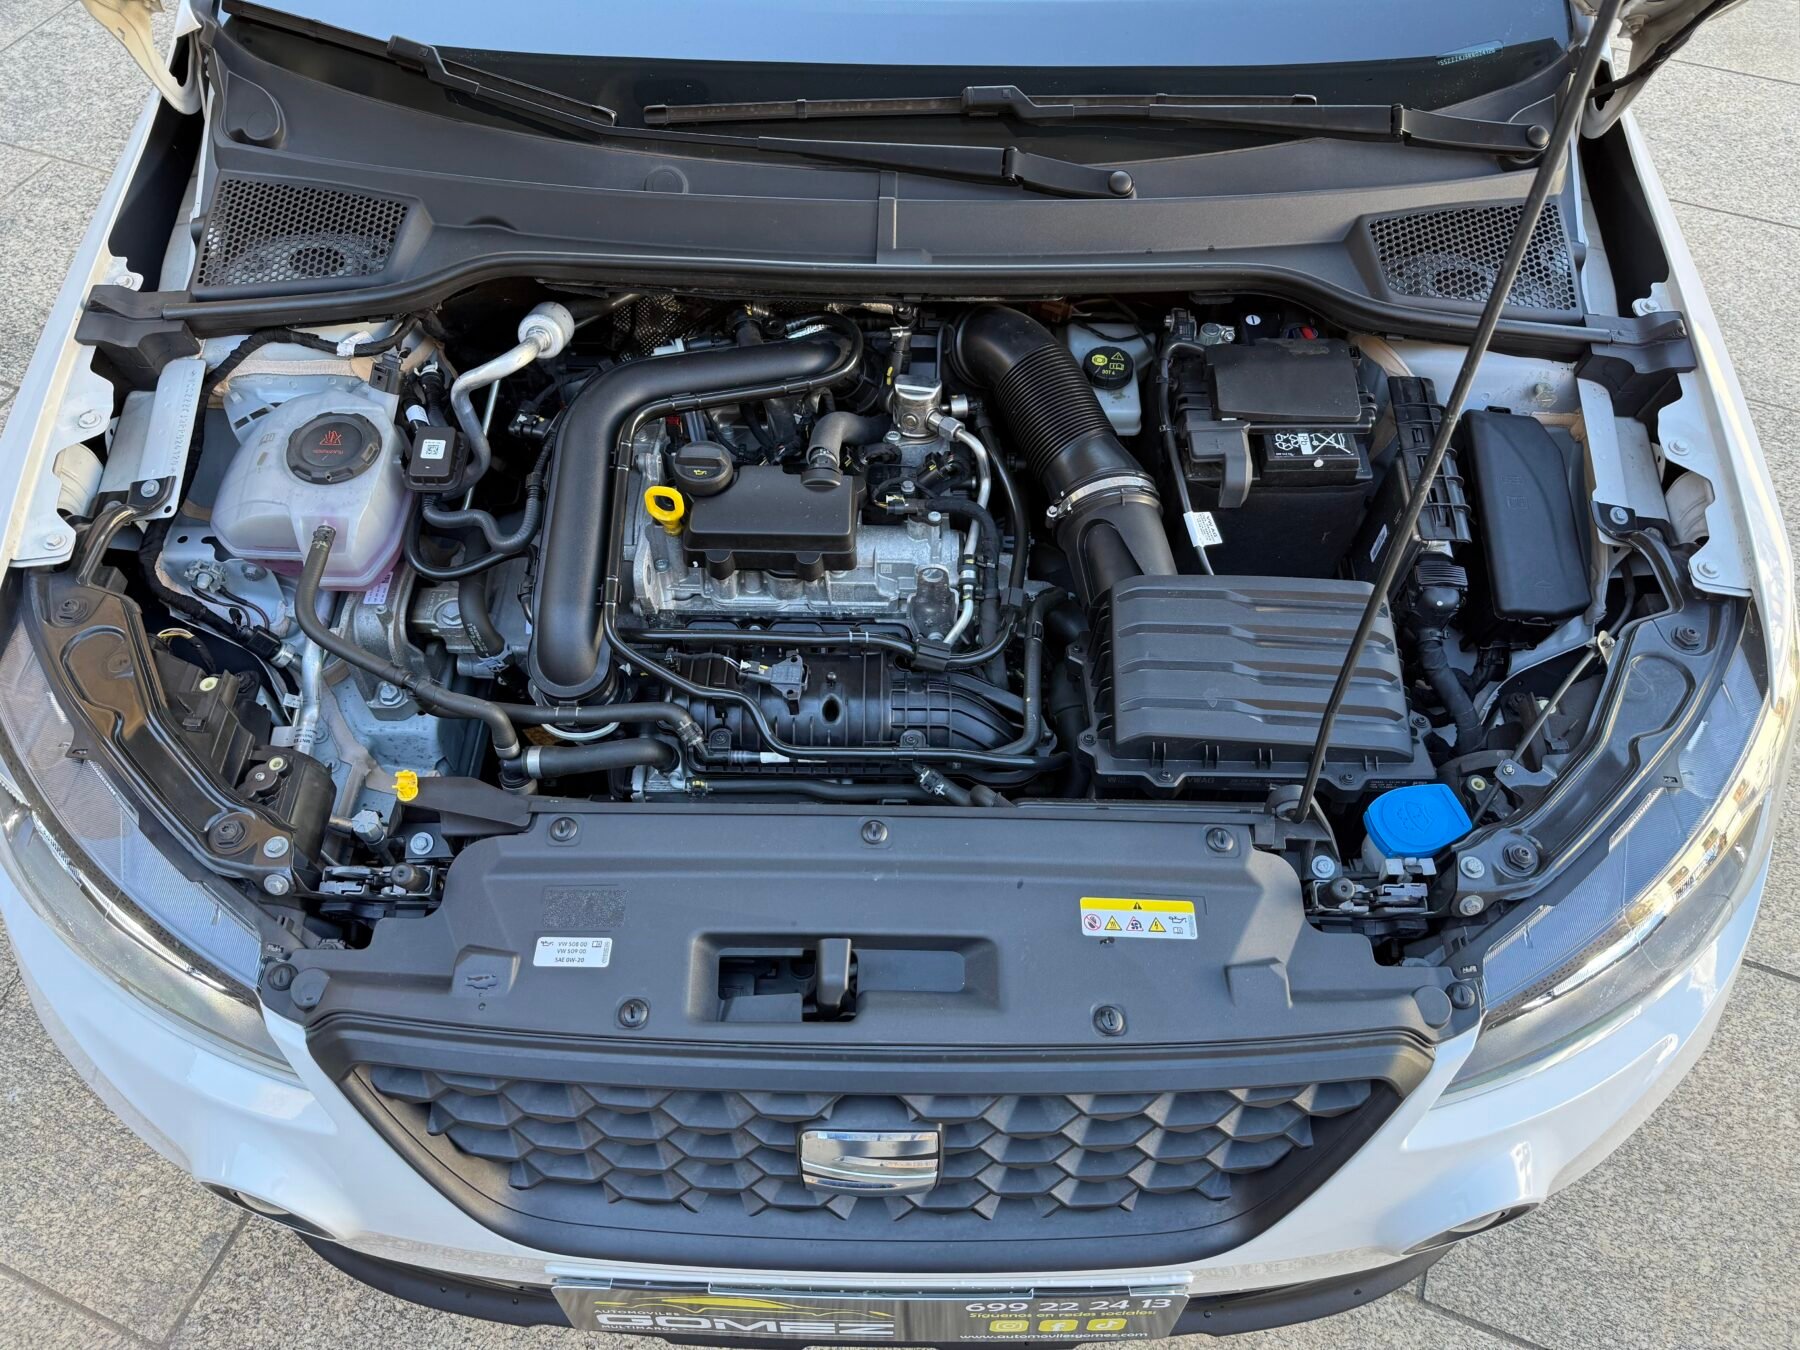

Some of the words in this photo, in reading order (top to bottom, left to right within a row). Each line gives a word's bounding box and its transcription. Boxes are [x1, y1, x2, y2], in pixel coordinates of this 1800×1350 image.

[1300, 435, 1308, 445] Pb
[965, 1302, 1029, 1312] 699
[1038, 1302, 1079, 1312] 22
[1089, 1299, 1130, 1310] 24
[1141, 1298, 1172, 1309] 13
[596, 1314, 895, 1335] GOMEZ
[960, 1331, 1148, 1340] www.automovilesgomez.com
